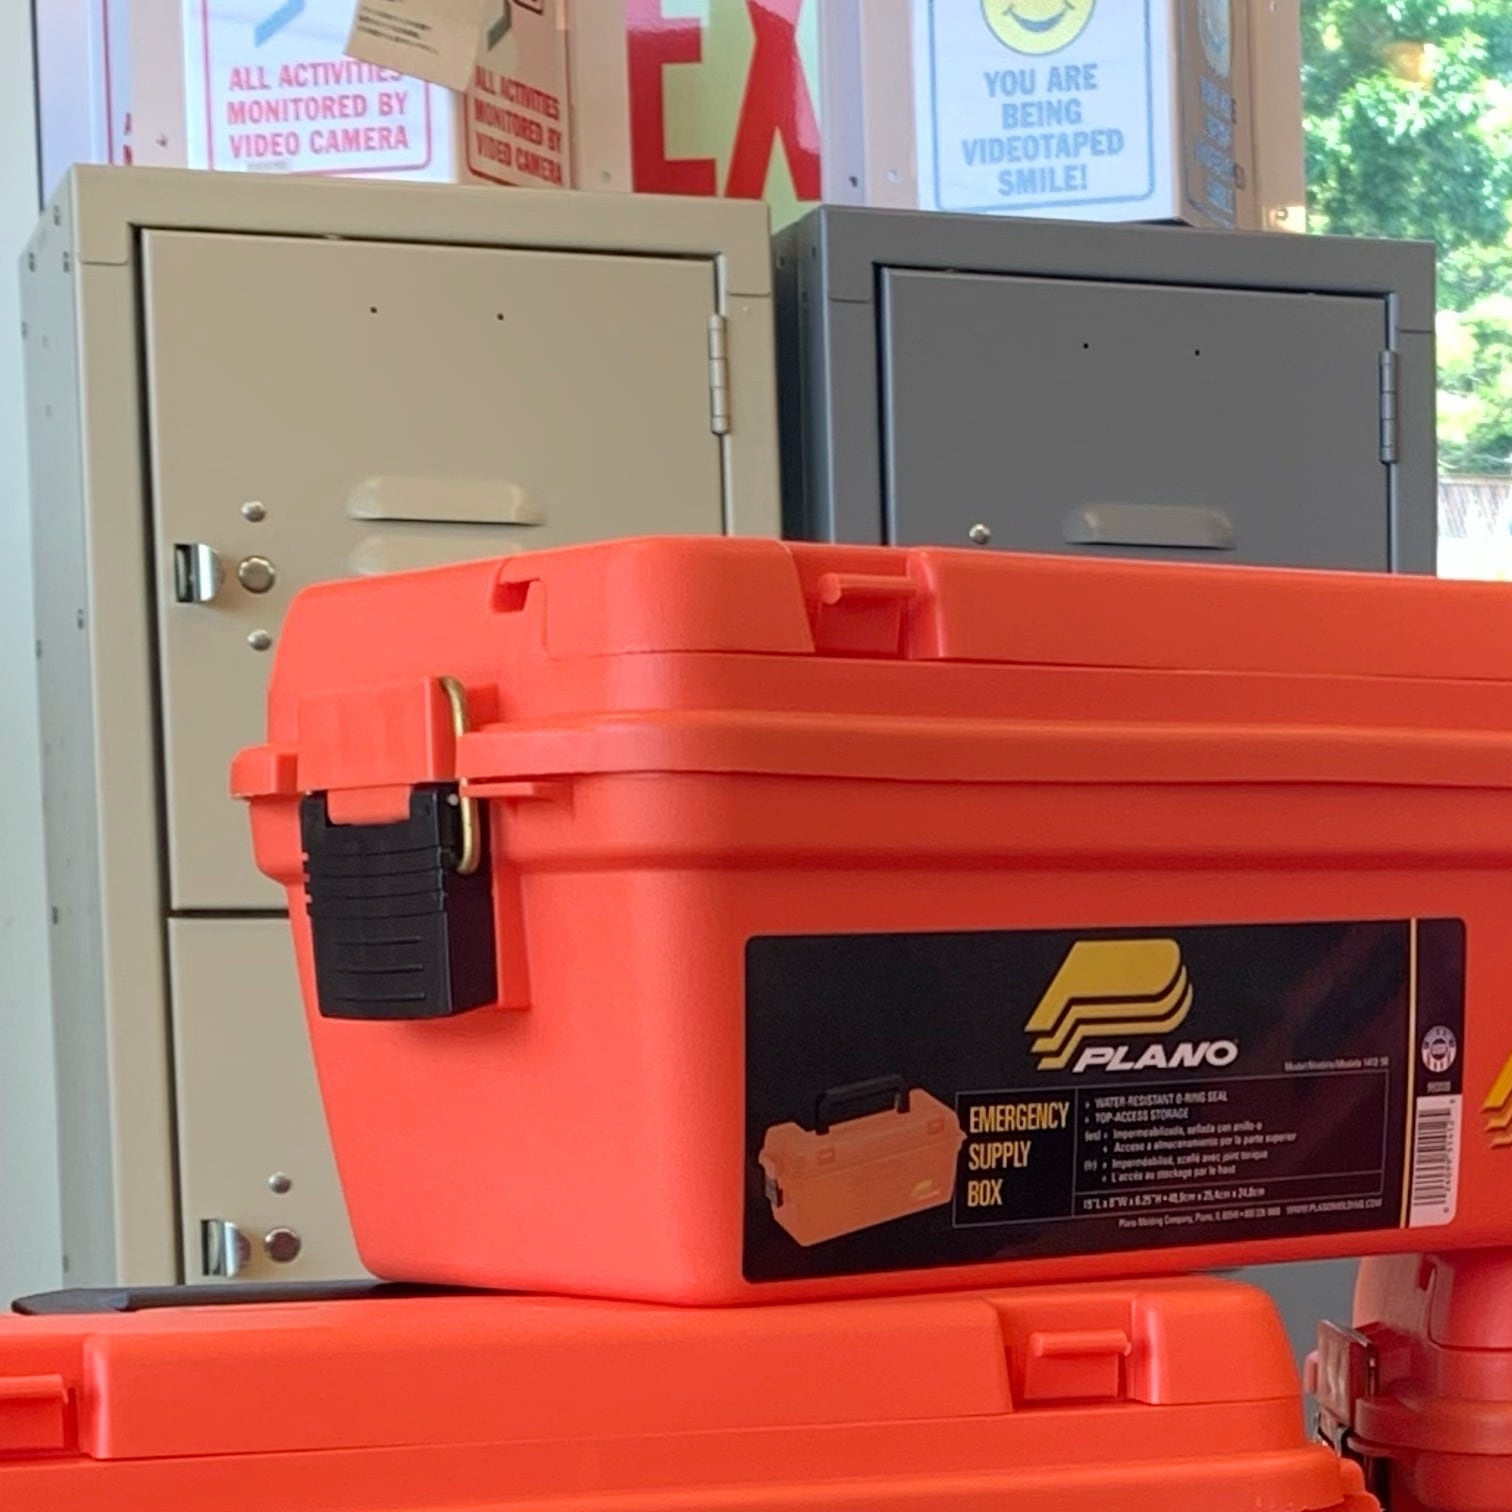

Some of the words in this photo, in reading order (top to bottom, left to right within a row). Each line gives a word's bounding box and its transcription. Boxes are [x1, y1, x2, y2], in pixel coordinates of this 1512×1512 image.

[229, 66, 271, 91] ALL
[983, 69, 1036, 98] YOU
[1047, 64, 1098, 93] ARE
[227, 94, 367, 125] MONITORED
[378, 91, 409, 117] BY
[1002, 99, 1082, 130] BEING
[229, 132, 300, 159] VIDEO
[309, 125, 409, 155] CAMERA
[961, 129, 1125, 166] VIDEOTAPED
[998, 165, 1088, 197] SMILE!
[1072, 1040, 1239, 1073] PLANO
[969, 1102, 1070, 1133] EMERGENCY
[968, 1141, 1031, 1170] SUPPLY
[967, 1178, 1004, 1207] BOX
